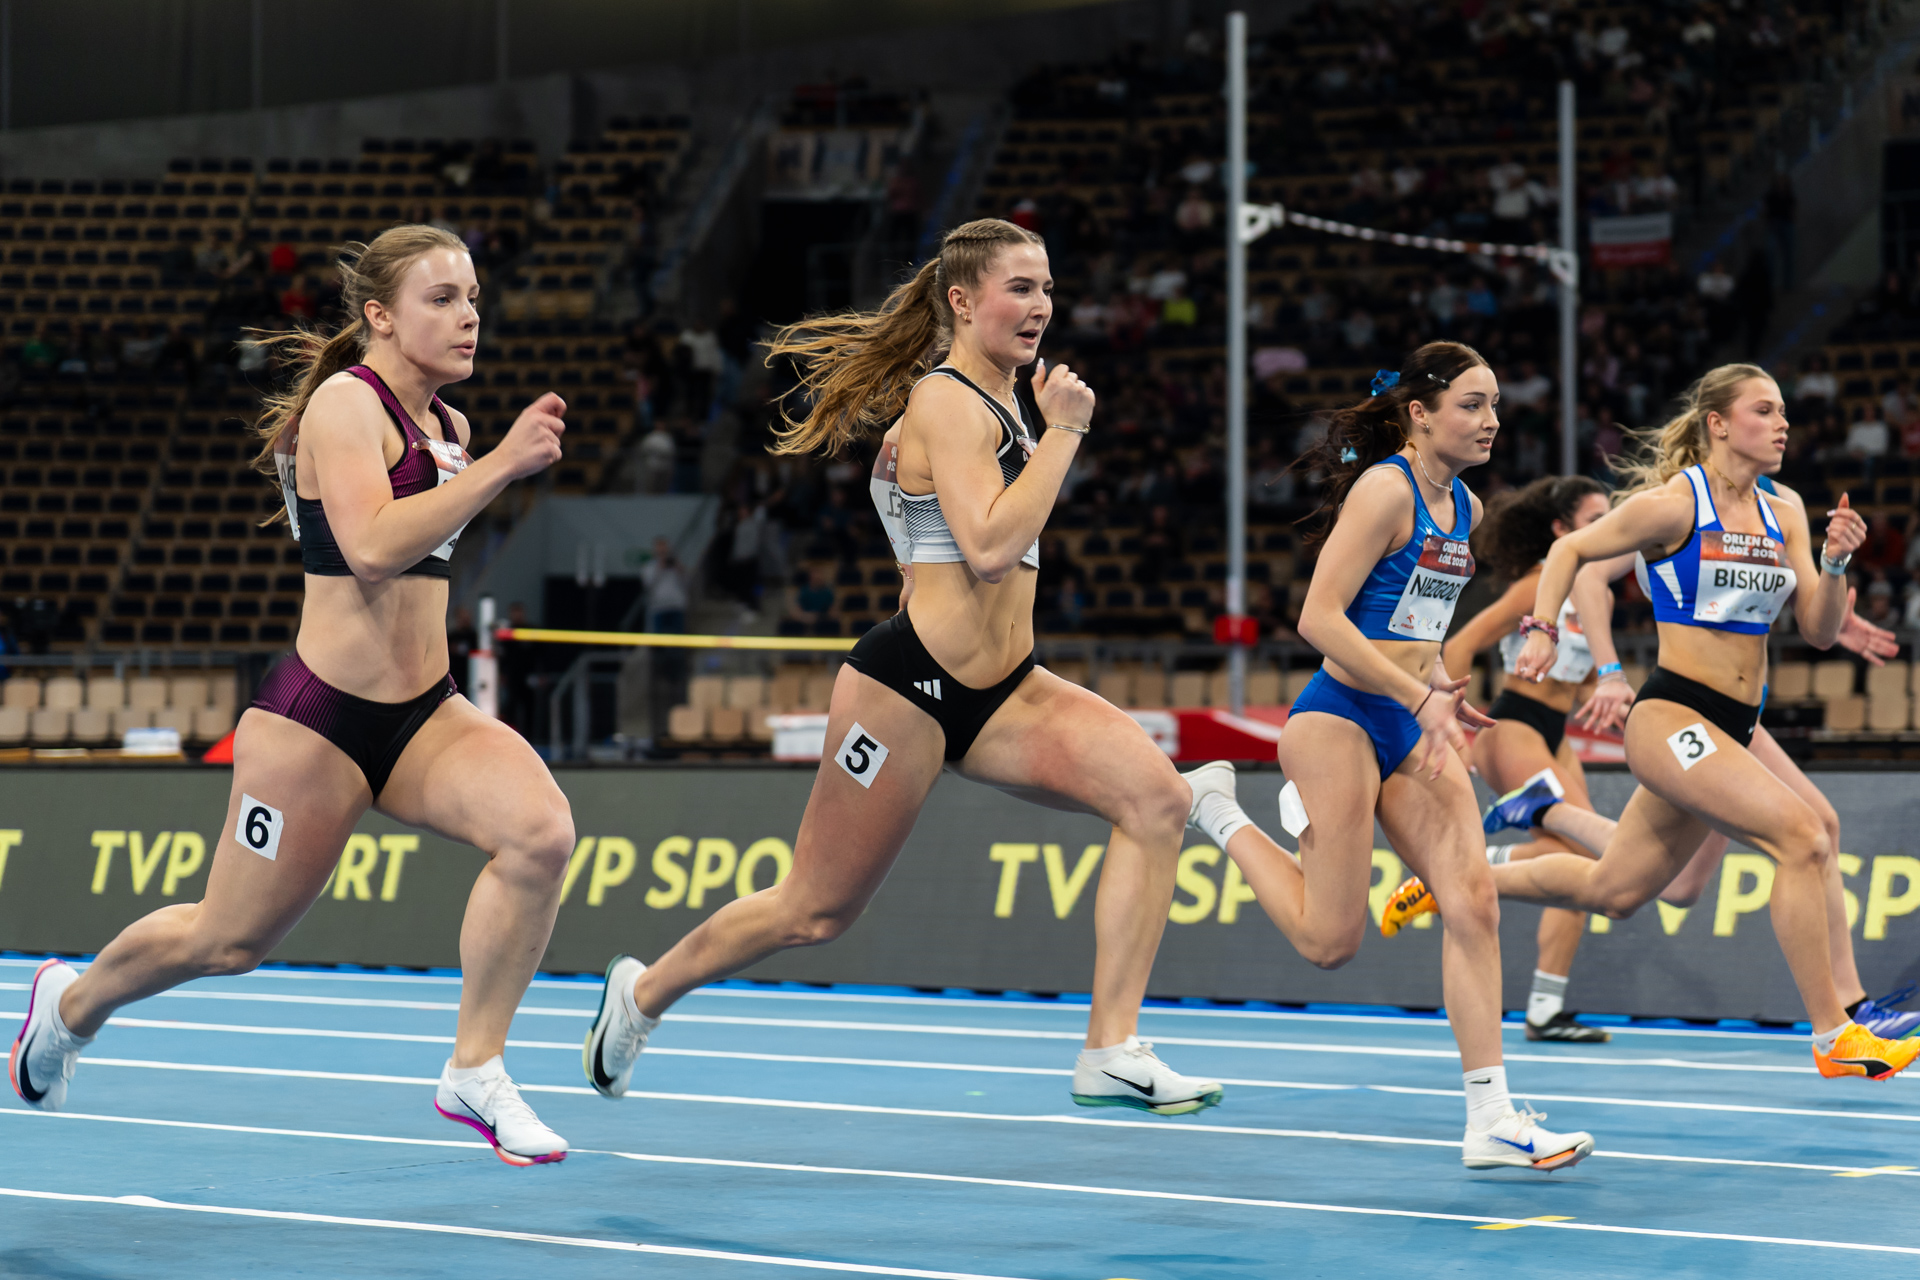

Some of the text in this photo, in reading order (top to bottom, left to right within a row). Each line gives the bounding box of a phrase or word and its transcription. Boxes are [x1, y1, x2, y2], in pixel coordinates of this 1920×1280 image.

[1722, 532, 1761, 547] ORLEN
[1714, 568, 1785, 593] BISKUP
[845, 733, 878, 775] 5
[1679, 730, 1705, 759] 3
[245, 805, 272, 850] 6
[91, 830, 420, 902] TVP RT
